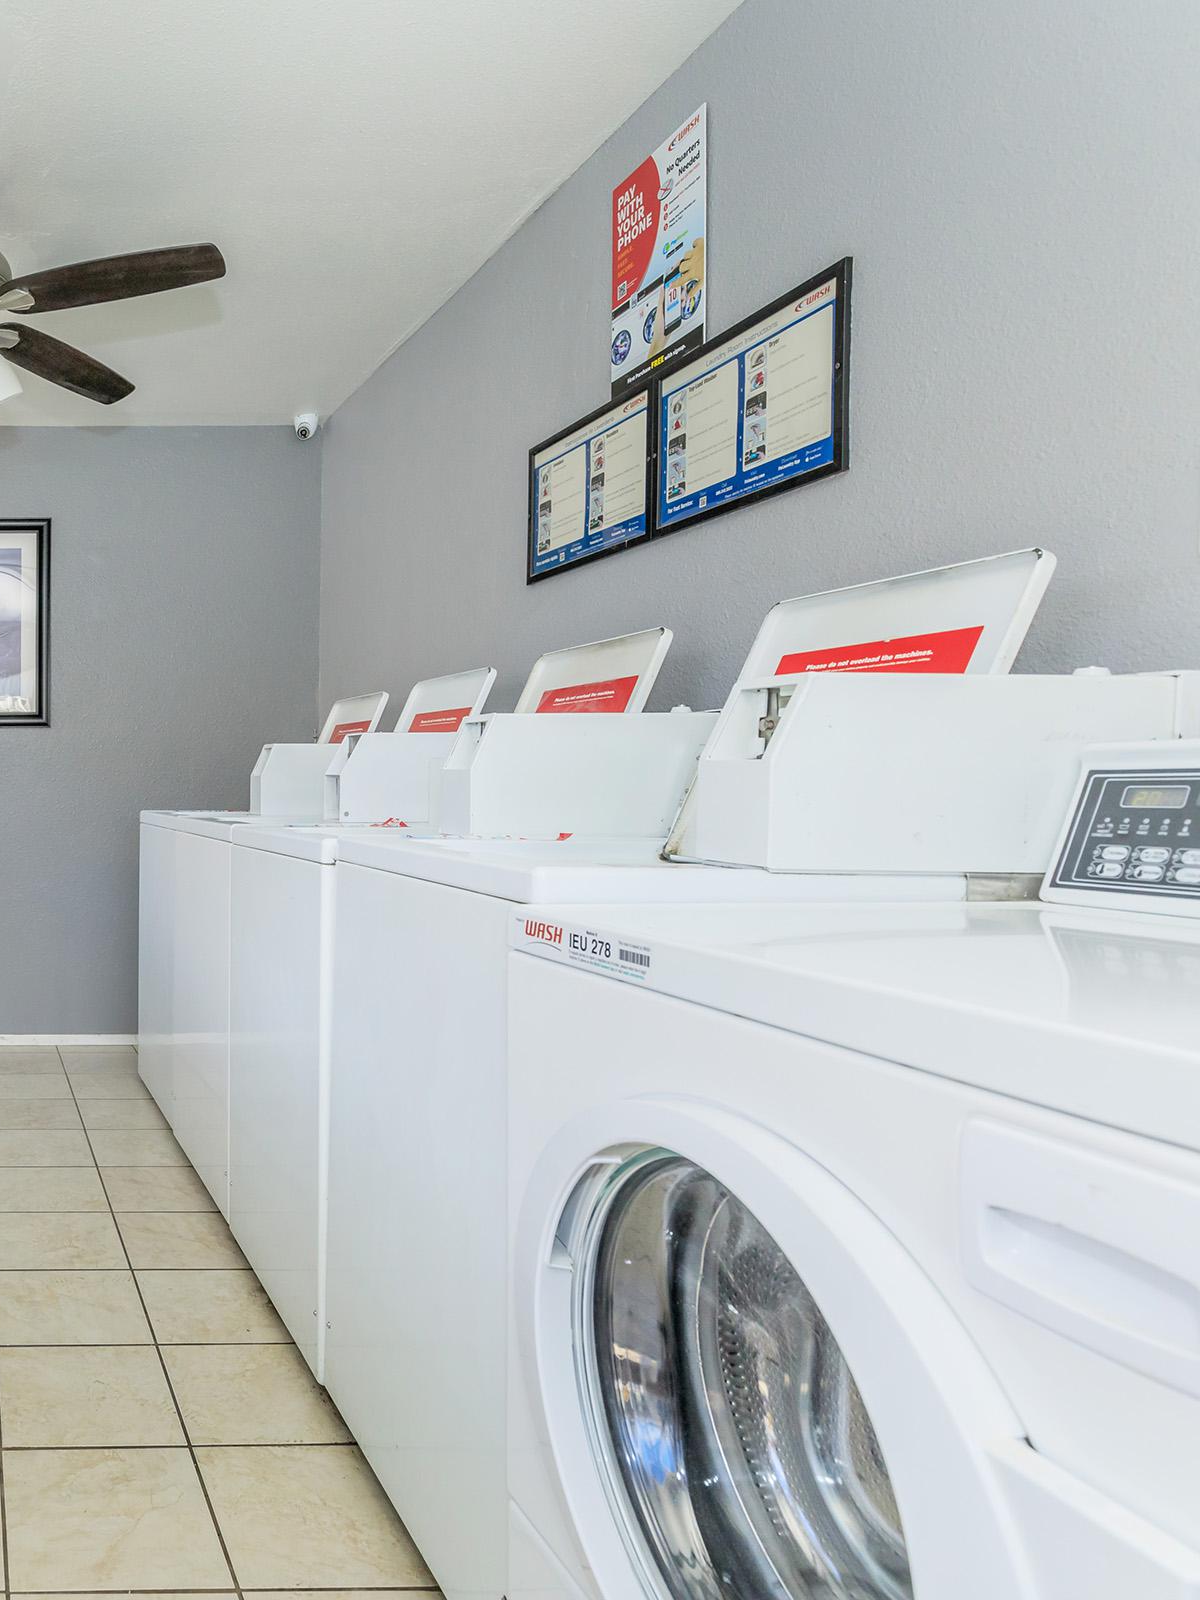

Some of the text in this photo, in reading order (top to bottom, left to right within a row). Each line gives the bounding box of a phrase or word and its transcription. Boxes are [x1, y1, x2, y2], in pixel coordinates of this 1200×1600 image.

[677, 114, 700, 142] WASH
[666, 163, 675, 175] No
[675, 139, 701, 166] Quarters
[678, 150, 701, 176] Needed
[617, 191, 643, 224] WITH
[618, 183, 636, 211] PAY
[617, 205, 645, 237] YOUR
[617, 211, 653, 252] PHONE
[668, 288, 677, 303] 10
[806, 285, 831, 306] WASH
[705, 321, 779, 367] Laundry Room Instructions
[768, 338, 781, 348] Dryer
[651, 355, 665, 369] FREE
[805, 662, 826, 671] Please
[837, 659, 849, 667] not
[849, 655, 880, 666] overload
[880, 654, 893, 662] the
[893, 649, 933, 660] machines.
[524, 919, 563, 944] WASH
[568, 932, 588, 952] IEU
[591, 938, 612, 958] 278
